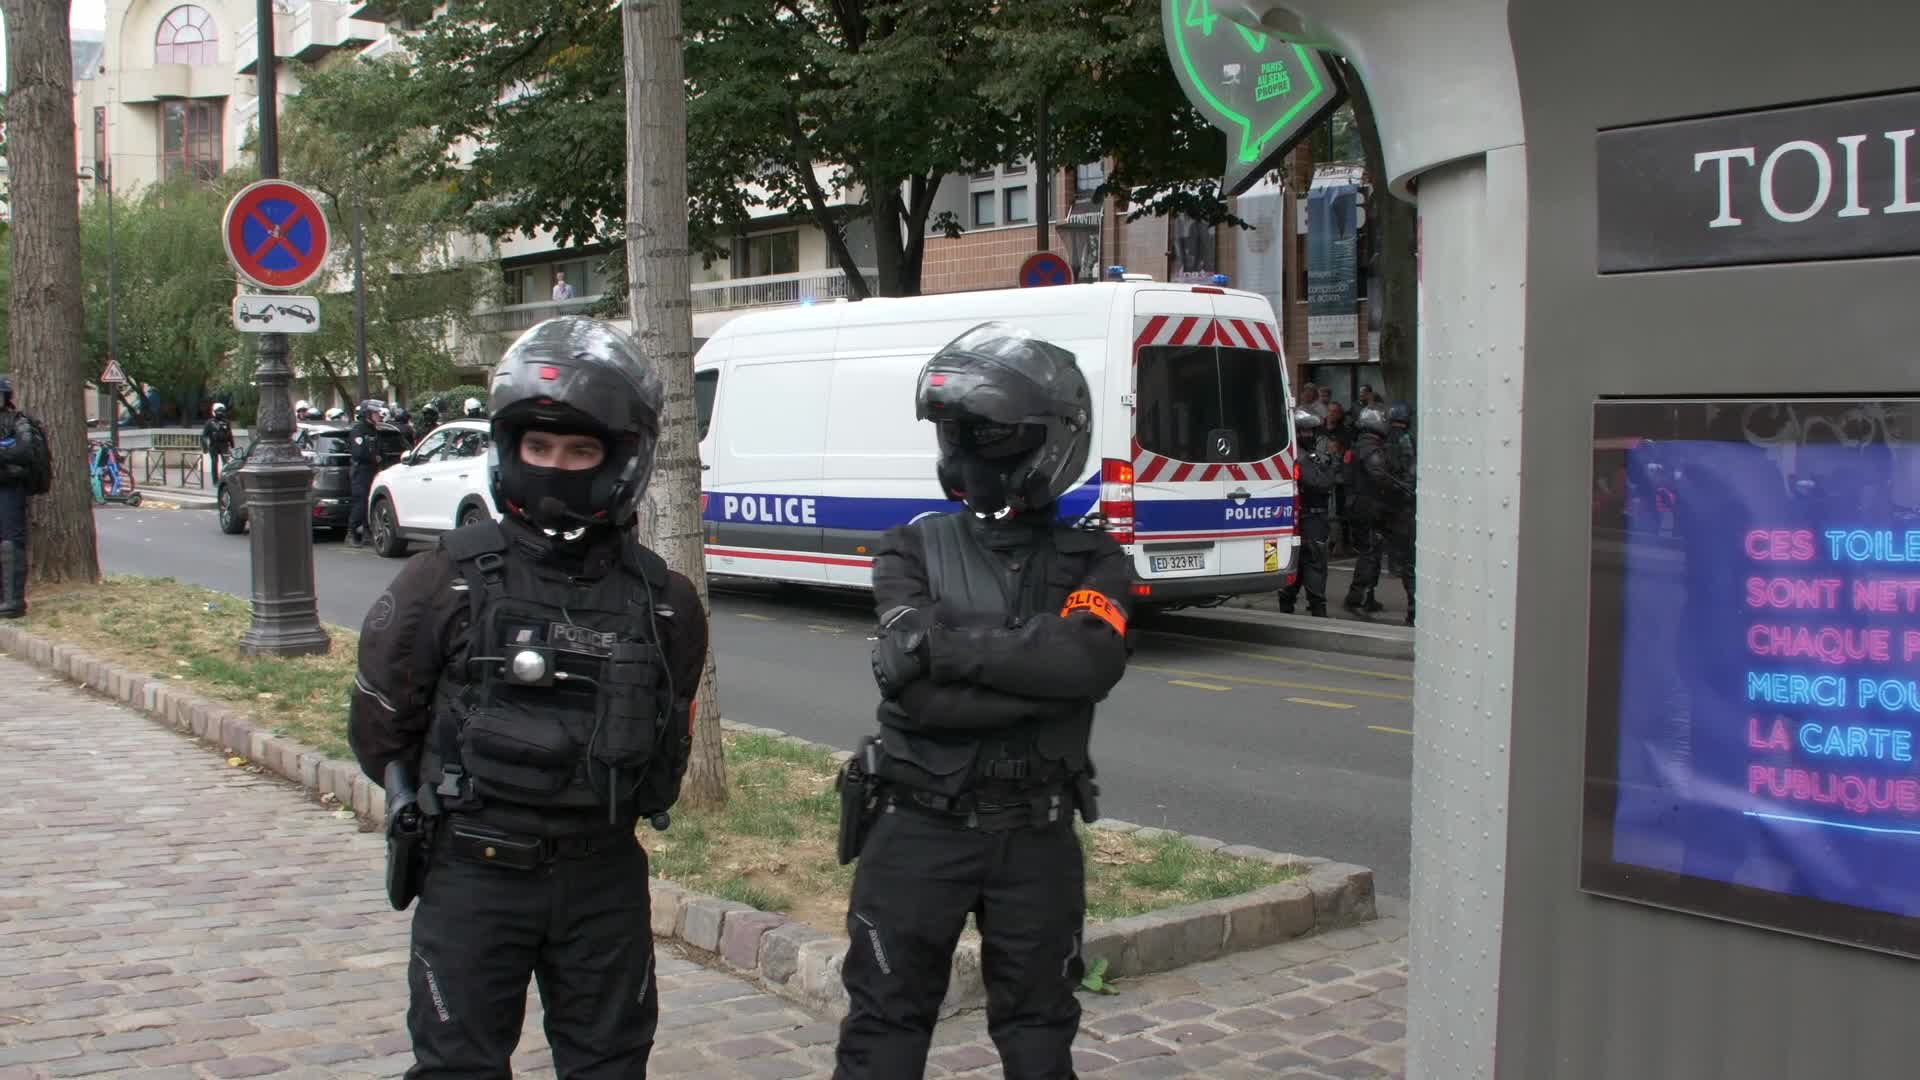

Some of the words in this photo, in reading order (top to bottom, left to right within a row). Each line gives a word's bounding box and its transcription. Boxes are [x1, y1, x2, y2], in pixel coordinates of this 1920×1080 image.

[1256, 80, 1290, 99] PROPRE
[1694, 129, 1920, 228] TOIL
[724, 495, 817, 525] POLICE
[1225, 506, 1271, 521] POLICE
[1745, 529, 1815, 561] CES
[1824, 529, 1920, 562] TOILE
[1746, 577, 1842, 609] SONT
[1853, 579, 1920, 612] NET
[553, 624, 614, 649] POLICE
[1748, 624, 1891, 664] CHAQUE
[1748, 671, 1846, 707] MERCI
[1749, 718, 1790, 750] LA
[1799, 722, 1912, 762] CARTE
[1749, 765, 1920, 813] PUBLIQUE
